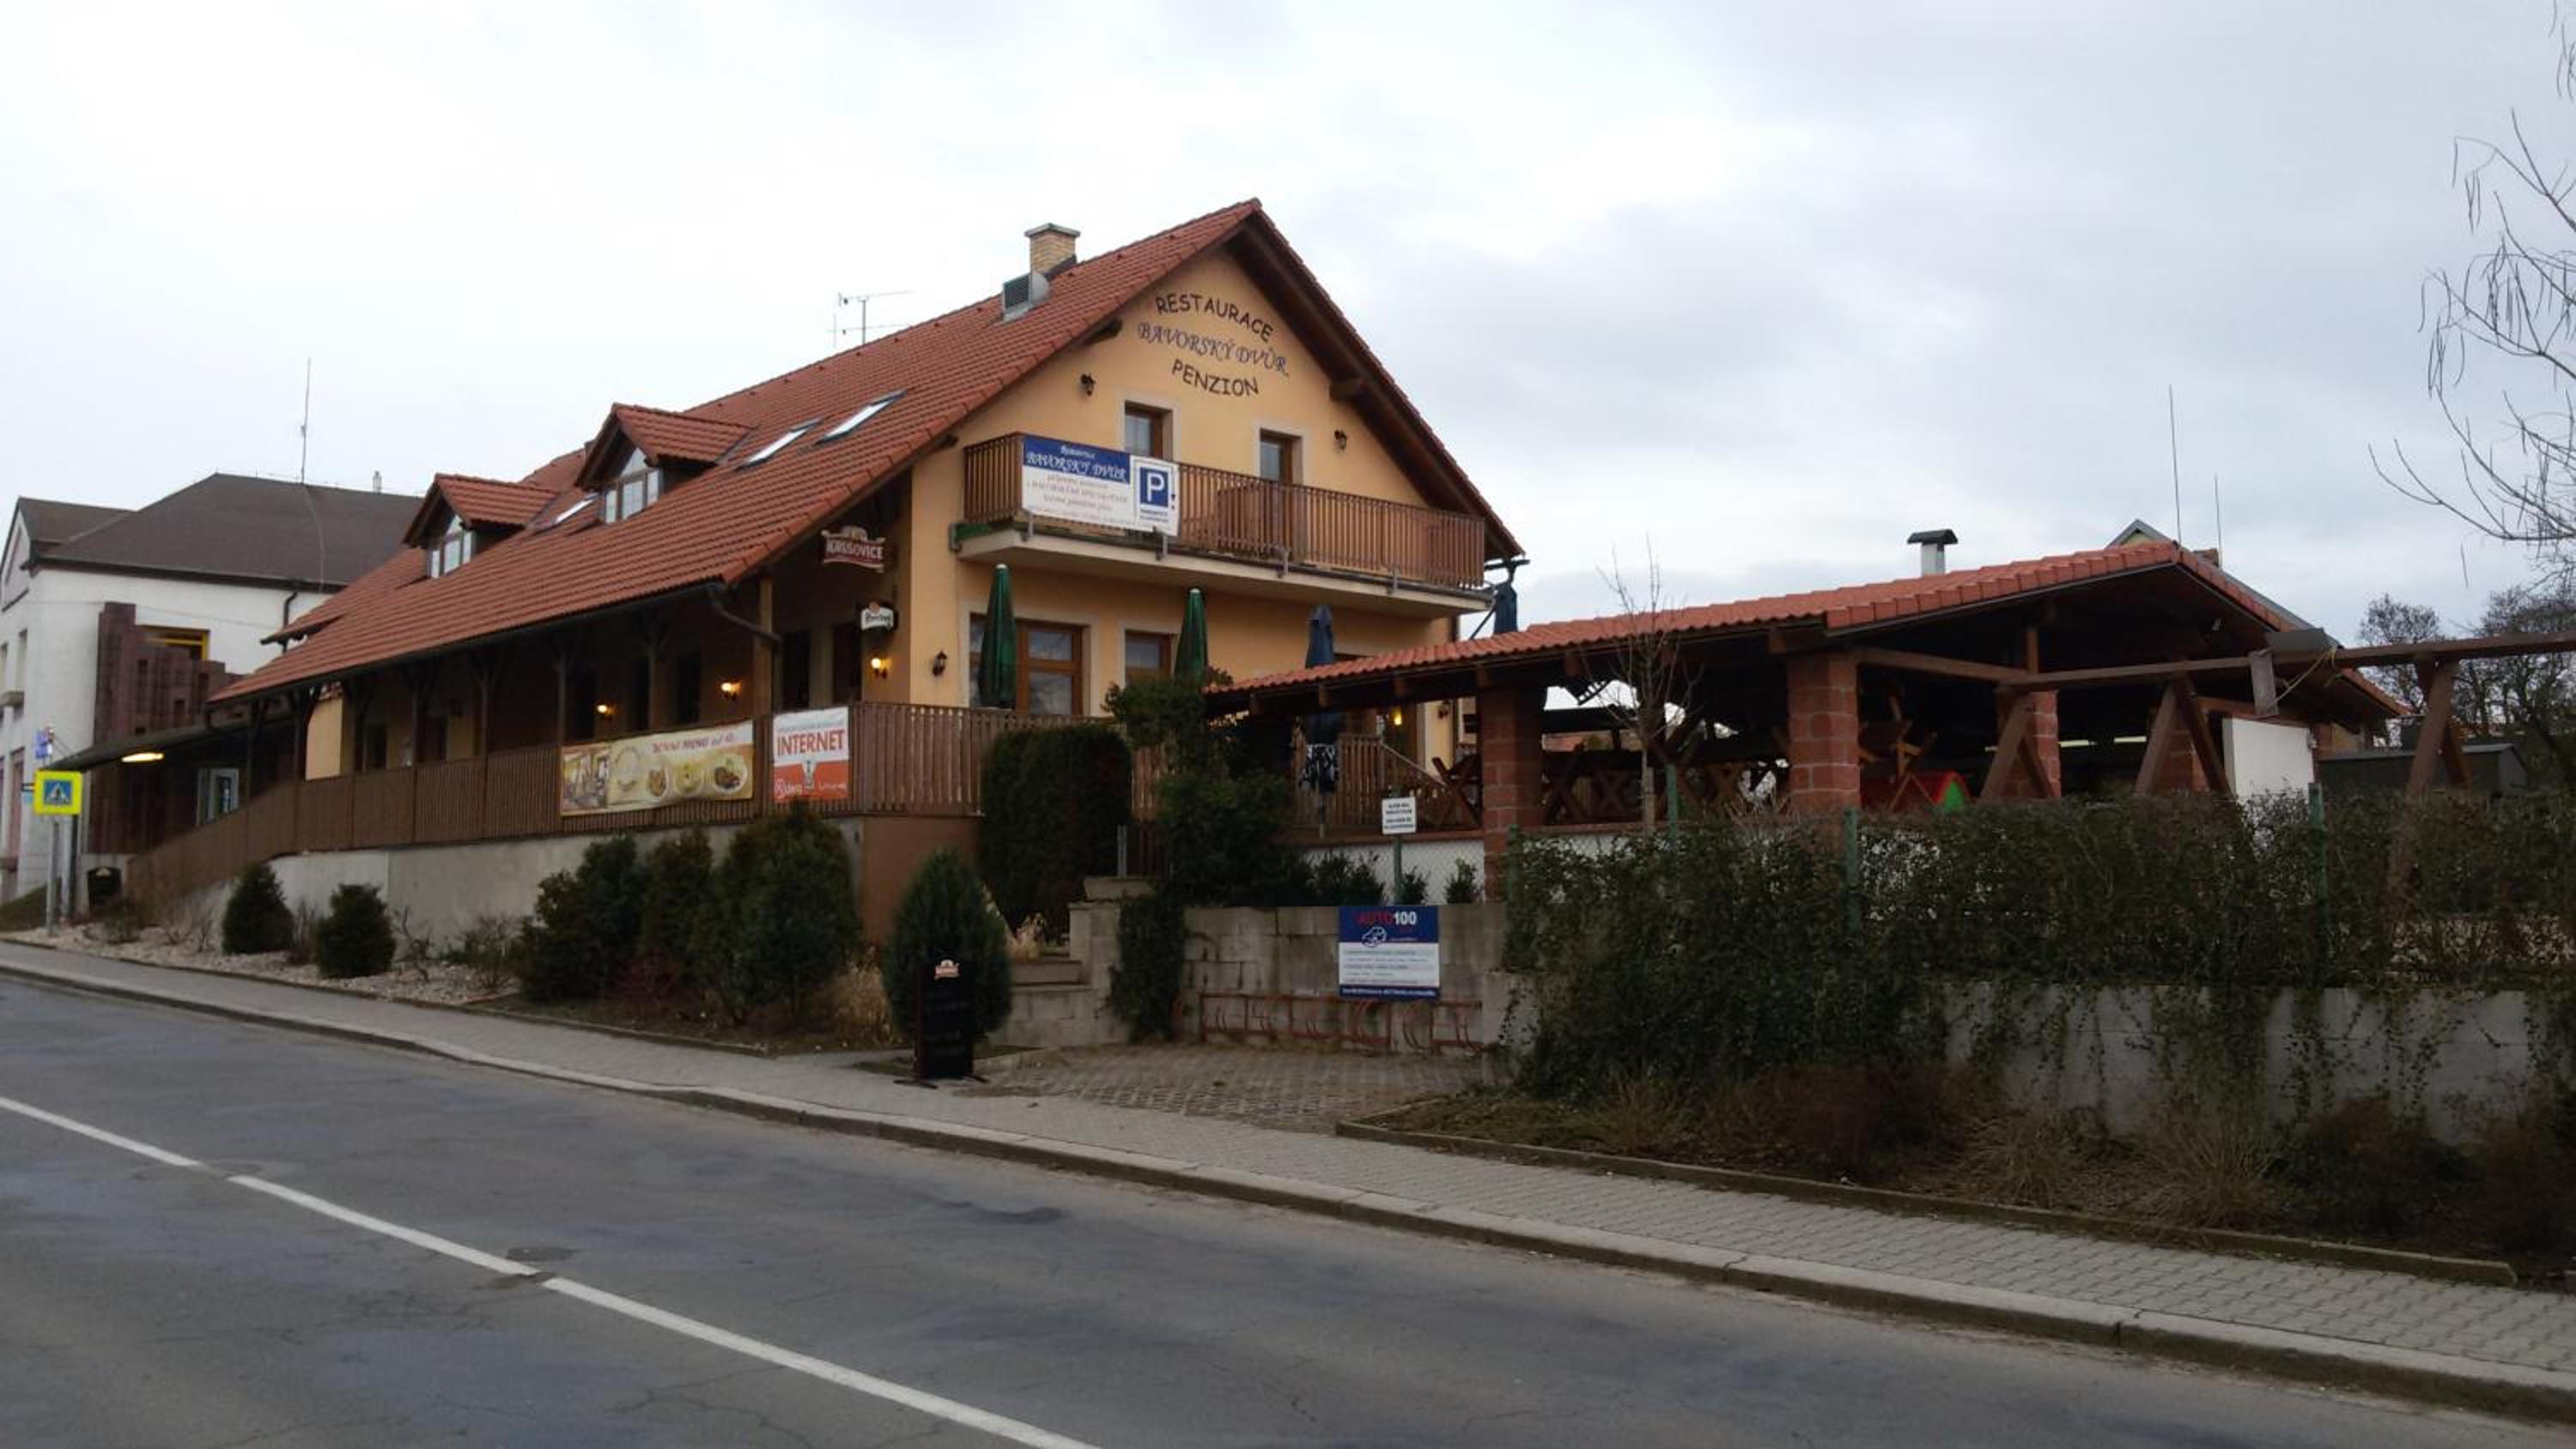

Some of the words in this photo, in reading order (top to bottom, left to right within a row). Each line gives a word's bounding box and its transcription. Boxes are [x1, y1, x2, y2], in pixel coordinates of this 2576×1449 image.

[1156, 293, 1273, 343] RESTAURACE
[1139, 321, 1235, 361] BAVORSKÝ
[1171, 359, 1259, 397] PENZION
[1147, 472, 1165, 501] P
[777, 729, 845, 755] INTERNET
